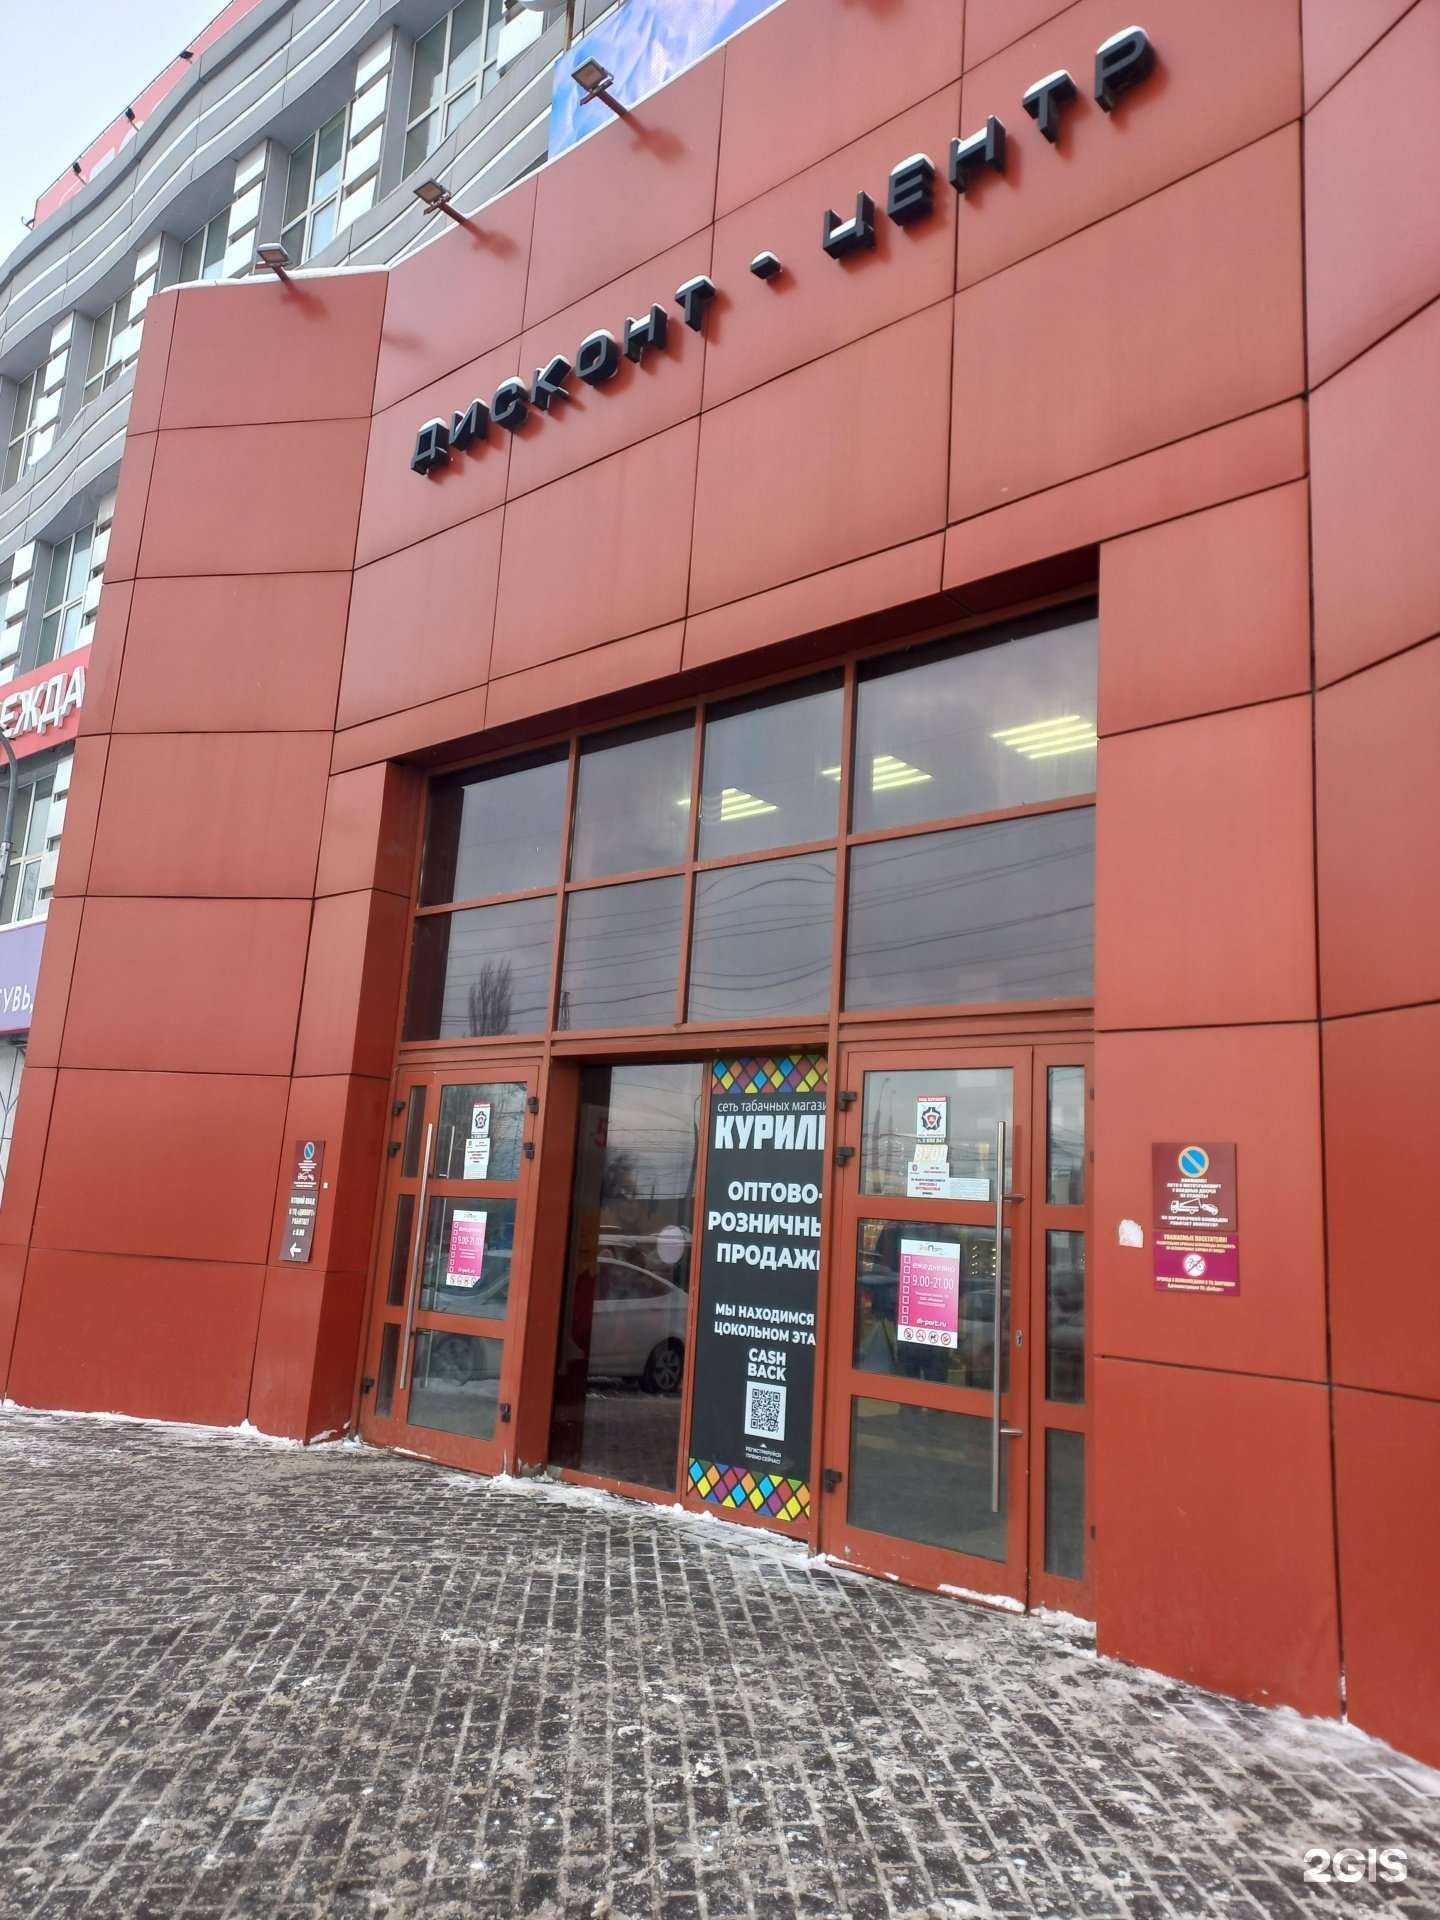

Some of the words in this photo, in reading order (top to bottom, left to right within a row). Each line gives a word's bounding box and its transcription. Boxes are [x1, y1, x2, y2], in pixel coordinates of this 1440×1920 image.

[411, 275, 715, 474] ДИСКОНТ
[822, 25, 1156, 259] ЦЕНТР
[0, 984, 34, 1015] УВЬ,
[717, 1102, 739, 1113] сеть
[741, 1100, 790, 1112] табачных
[714, 1114, 827, 1150] КУРИЛ
[716, 1242, 820, 1271] ПРОДАЖ
[715, 1303, 735, 1318] МЫ
[738, 1304, 815, 1326] НАХОДИМСЯ
[714, 1321, 789, 1343] ЦОКОЛЬНОМ
[791, 1331, 817, 1346] ЭТА
[748, 1347, 787, 1366] CASH
[747, 1362, 787, 1381] BACK
